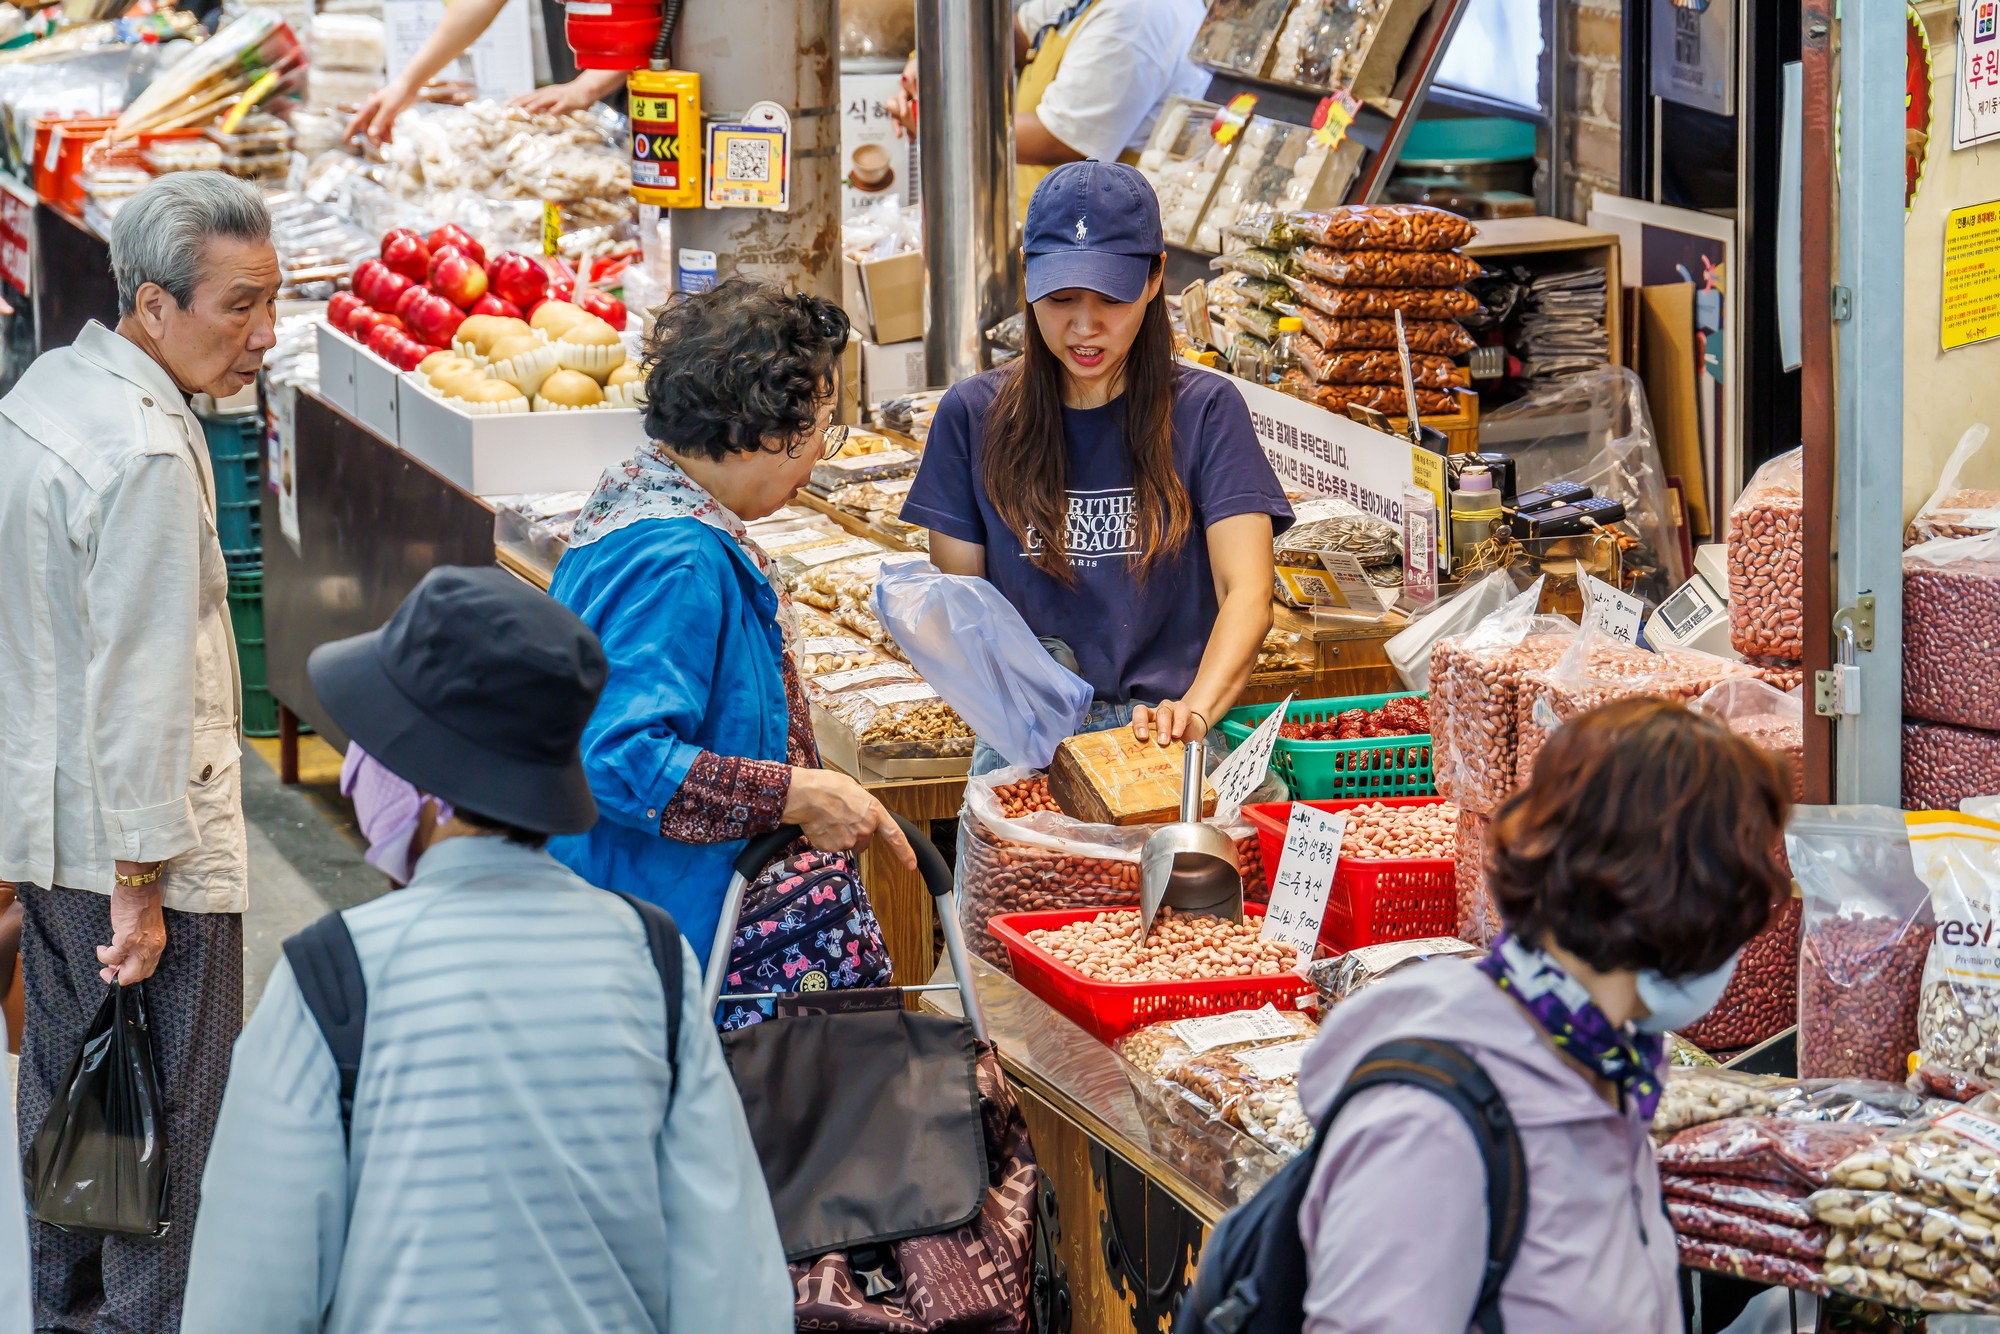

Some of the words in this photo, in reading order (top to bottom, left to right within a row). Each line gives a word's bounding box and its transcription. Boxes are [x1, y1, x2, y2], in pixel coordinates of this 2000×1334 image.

[1251, 411, 1275, 441] 모바일
[1275, 420, 1299, 450] 결제를
[1300, 430, 1350, 471] 부탁드립니다.
[1299, 461, 1315, 489] 현금
[1316, 468, 1348, 498] 영수증을
[1359, 486, 1403, 527] 받아가세요!
[1066, 558, 1098, 568] ARIS
[1290, 871, 1323, 902] 중국산
[1955, 954, 1992, 965] Premium
